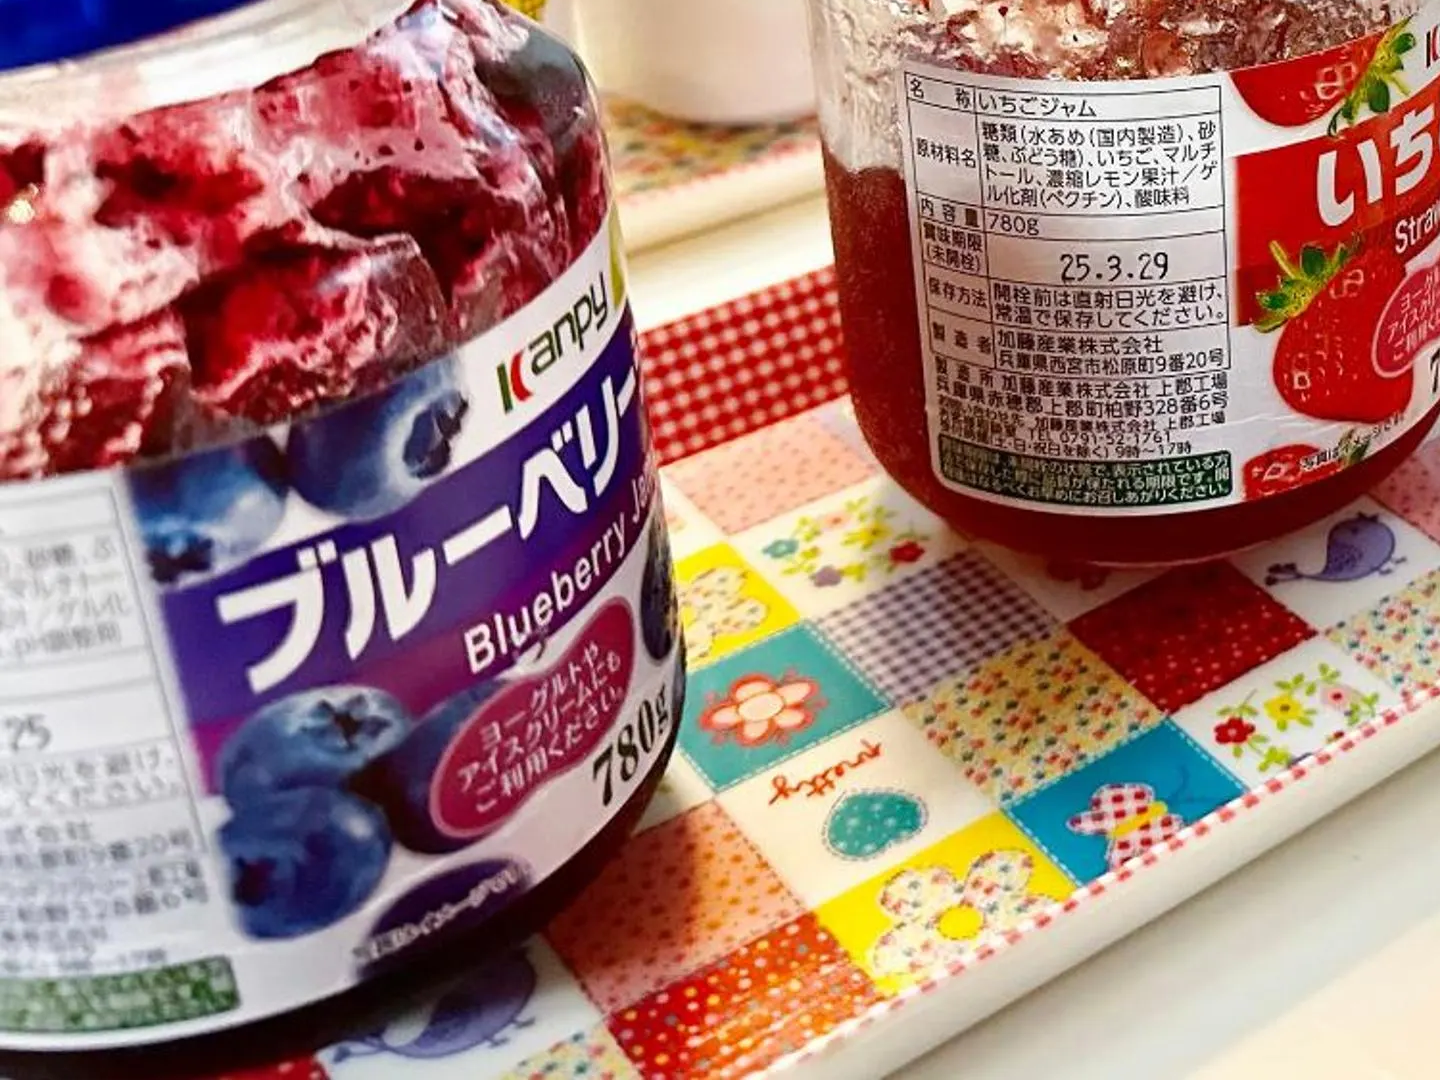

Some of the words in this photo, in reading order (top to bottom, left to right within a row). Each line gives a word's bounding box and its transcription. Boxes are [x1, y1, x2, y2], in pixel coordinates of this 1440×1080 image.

[978, 91, 1097, 118] いちごジャム
[915, 137, 978, 169] 原材料名
[987, 213, 1040, 236] 780g
[1059, 251, 1169, 283] 25.3.29
[928, 276, 988, 309] 保存方法
[993, 282, 1222, 308] 開栓前は直射日光を避け、
[994, 301, 1225, 328] 常温で保存してください。
[496, 271, 609, 414] Kanpy
[998, 328, 1163, 355] 加藤産業株式会社
[216, 365, 637, 696] ブルーベリー
[463, 510, 627, 676] Blueberry
[478, 639, 600, 753] ヨーグルトや
[457, 651, 622, 794] アイスクリームにも
[591, 682, 673, 808] 780g
[768, 738, 884, 806] pretty
